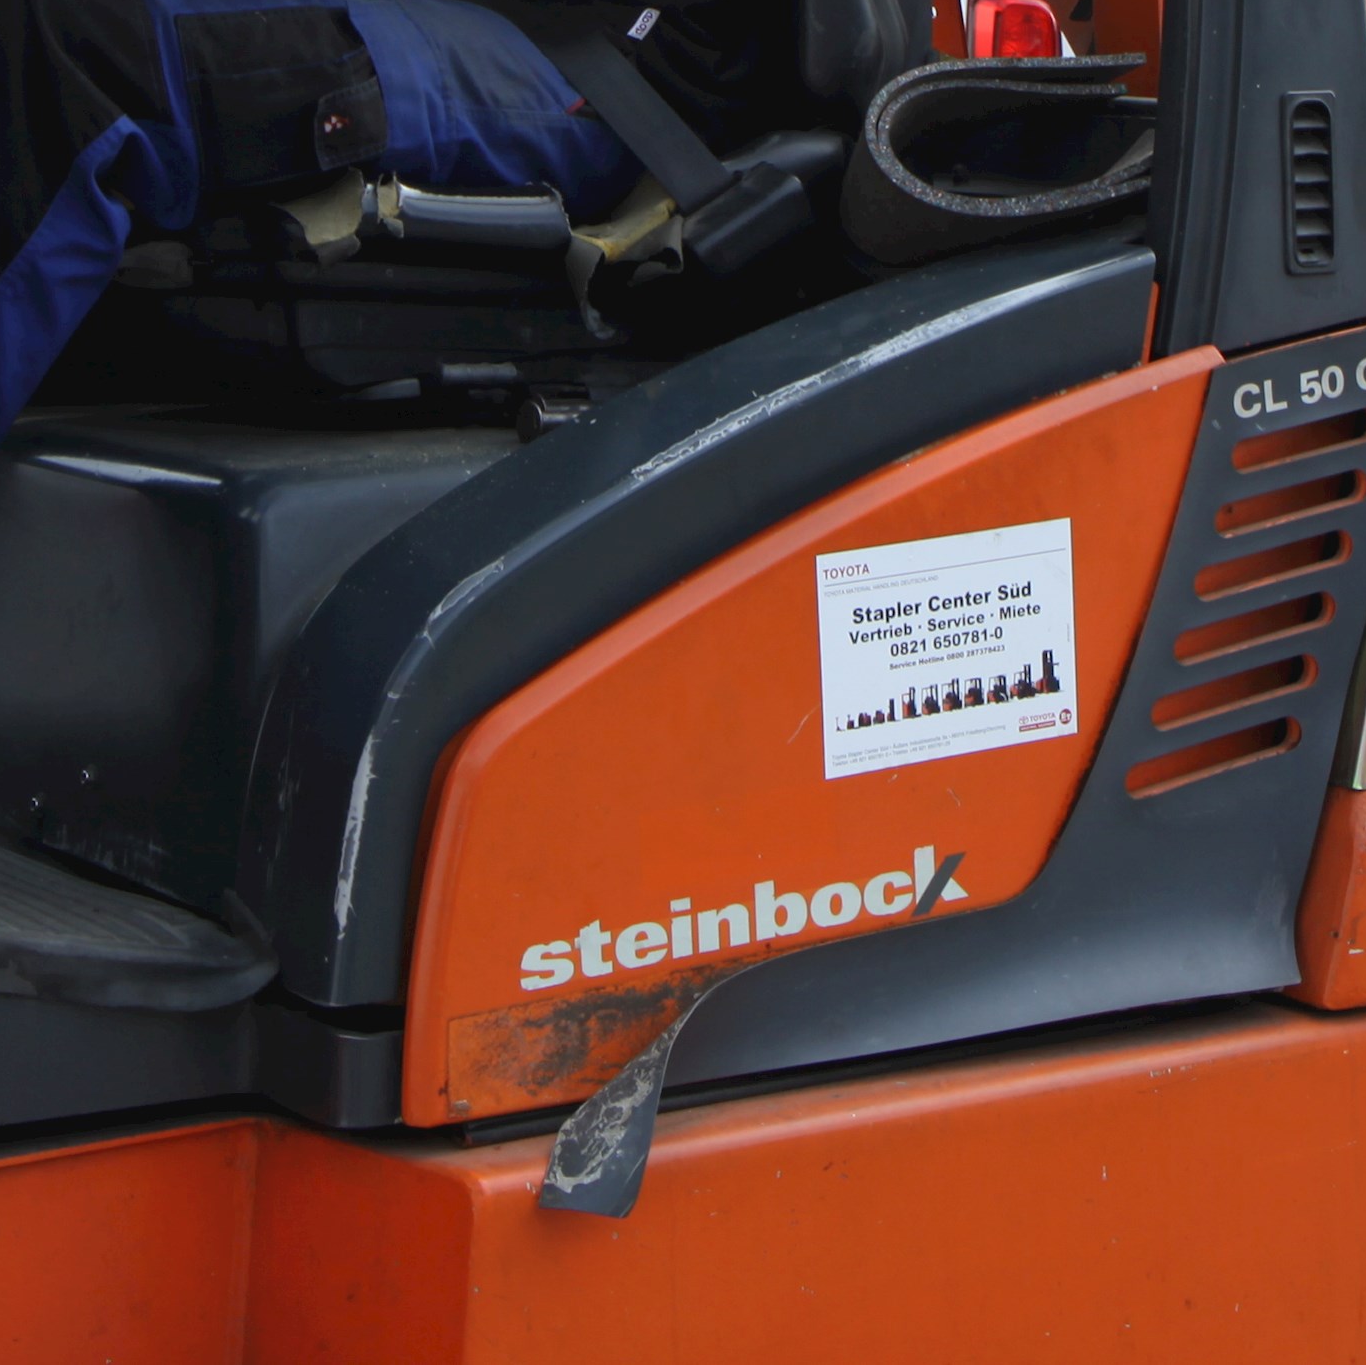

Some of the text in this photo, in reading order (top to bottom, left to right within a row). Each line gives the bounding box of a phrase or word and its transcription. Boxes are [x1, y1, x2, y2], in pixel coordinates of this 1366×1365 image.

[1233, 379, 1288, 419] CL
[1299, 365, 1345, 405] 50
[823, 563, 870, 580] TOYOTA
[852, 581, 1032, 624] Stapler Center Süd
[848, 603, 1041, 645] Vertrieb Service Miete
[890, 626, 1004, 657] 0821 650781-0
[889, 660, 916, 671] Service
[918, 655, 945, 666] Hotline
[946, 651, 965, 661] 0800
[1030, 712, 1056, 722] TOYOTA
[519, 844, 969, 991] steinbock
